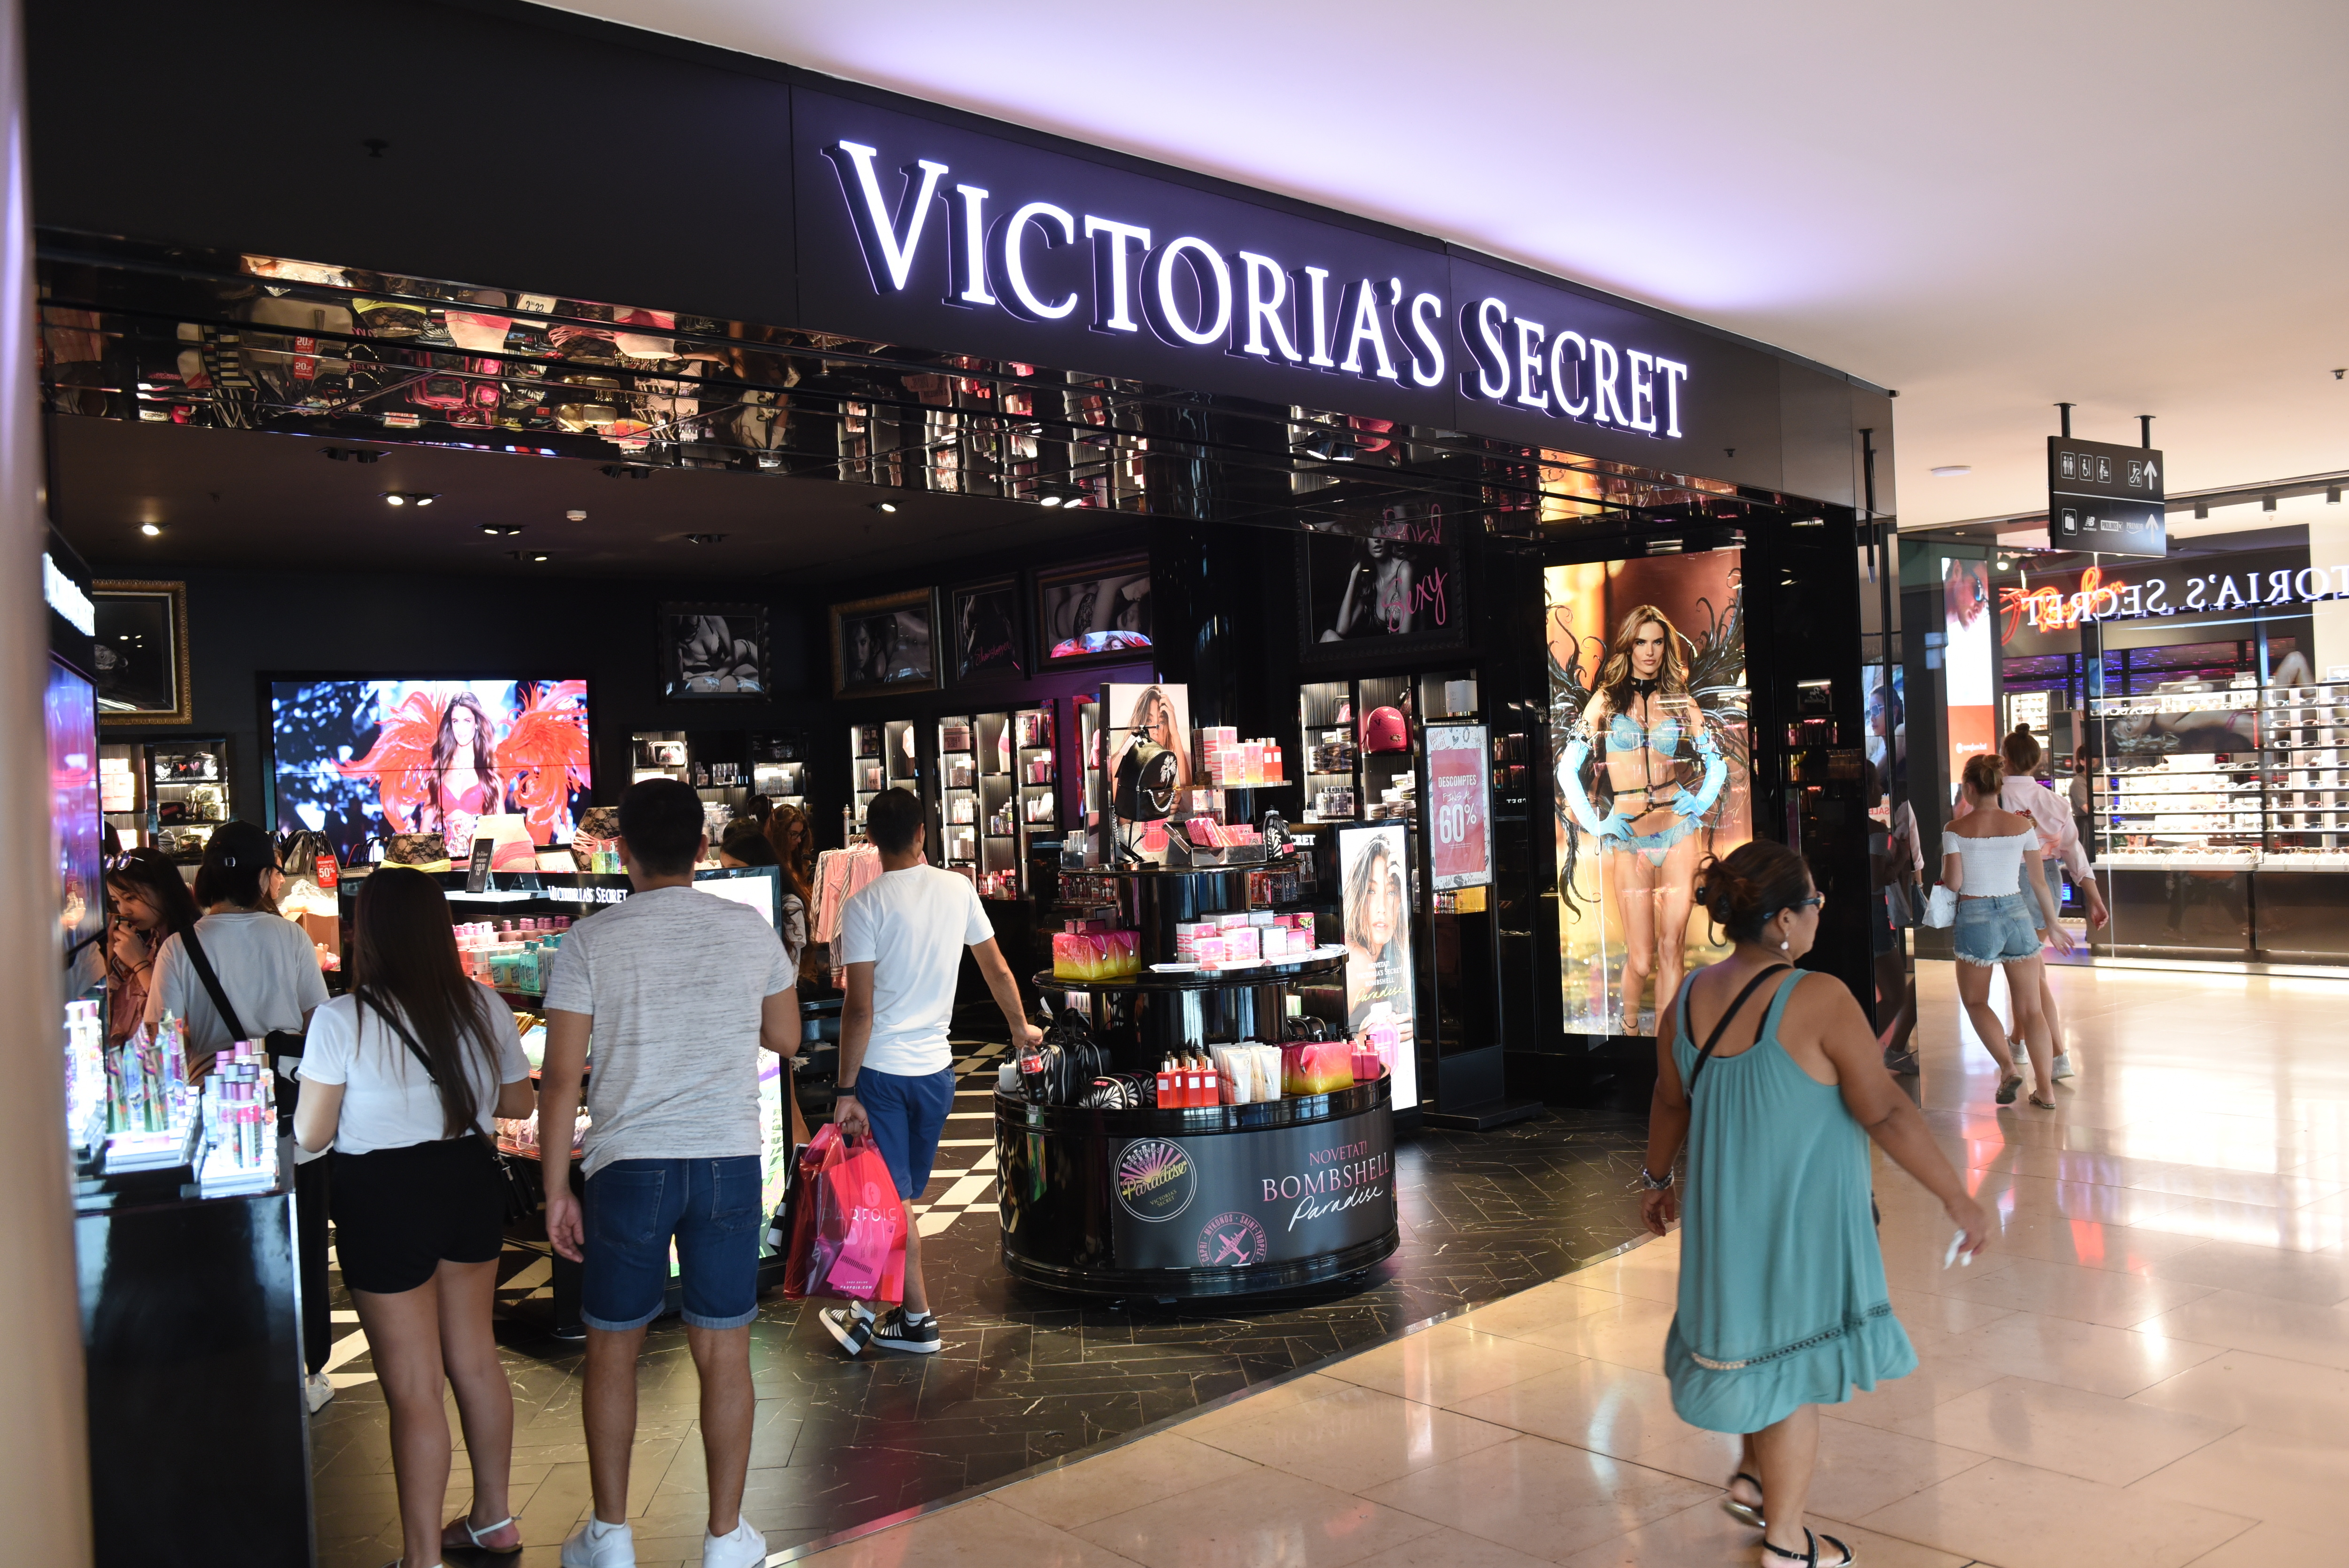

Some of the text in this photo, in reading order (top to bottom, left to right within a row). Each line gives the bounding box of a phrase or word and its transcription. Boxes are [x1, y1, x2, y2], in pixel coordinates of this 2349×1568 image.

[836, 139, 1688, 438] VICTORIA'S SECRET
[2101, 521, 2118, 530] PIKOLINOS
[1381, 567, 1448, 633] Sexy
[1438, 774, 1477, 788] DESCOMPTES
[1443, 791, 1473, 803] FINS AL
[1439, 803, 1477, 844] 60%
[1291, 834, 1316, 846] CRET
[319, 867, 335, 878] 50%
[547, 885, 628, 903] VICTORIA'S SECRET
[1365, 977, 1395, 987] BOMBSHELL
[1353, 985, 1408, 1009] Paradise
[1126, 1146, 1161, 1168] GREETINGS
[1309, 1140, 1368, 1166] NOVETAT!
[1136, 1156, 1154, 1169] FROM
[1122, 1162, 1187, 1201] Paradise
[1261, 1152, 1390, 1202] BOMBSHELL
[1150, 1188, 1177, 1206] VICTORIA'S
[1157, 1195, 1175, 1208] SECRET
[824, 1208, 896, 1222] PARFOIS
[1288, 1186, 1384, 1232] Paradise
[1199, 1214, 1265, 1262] CAPRI MYKONOS SAINT-TROPEZ
